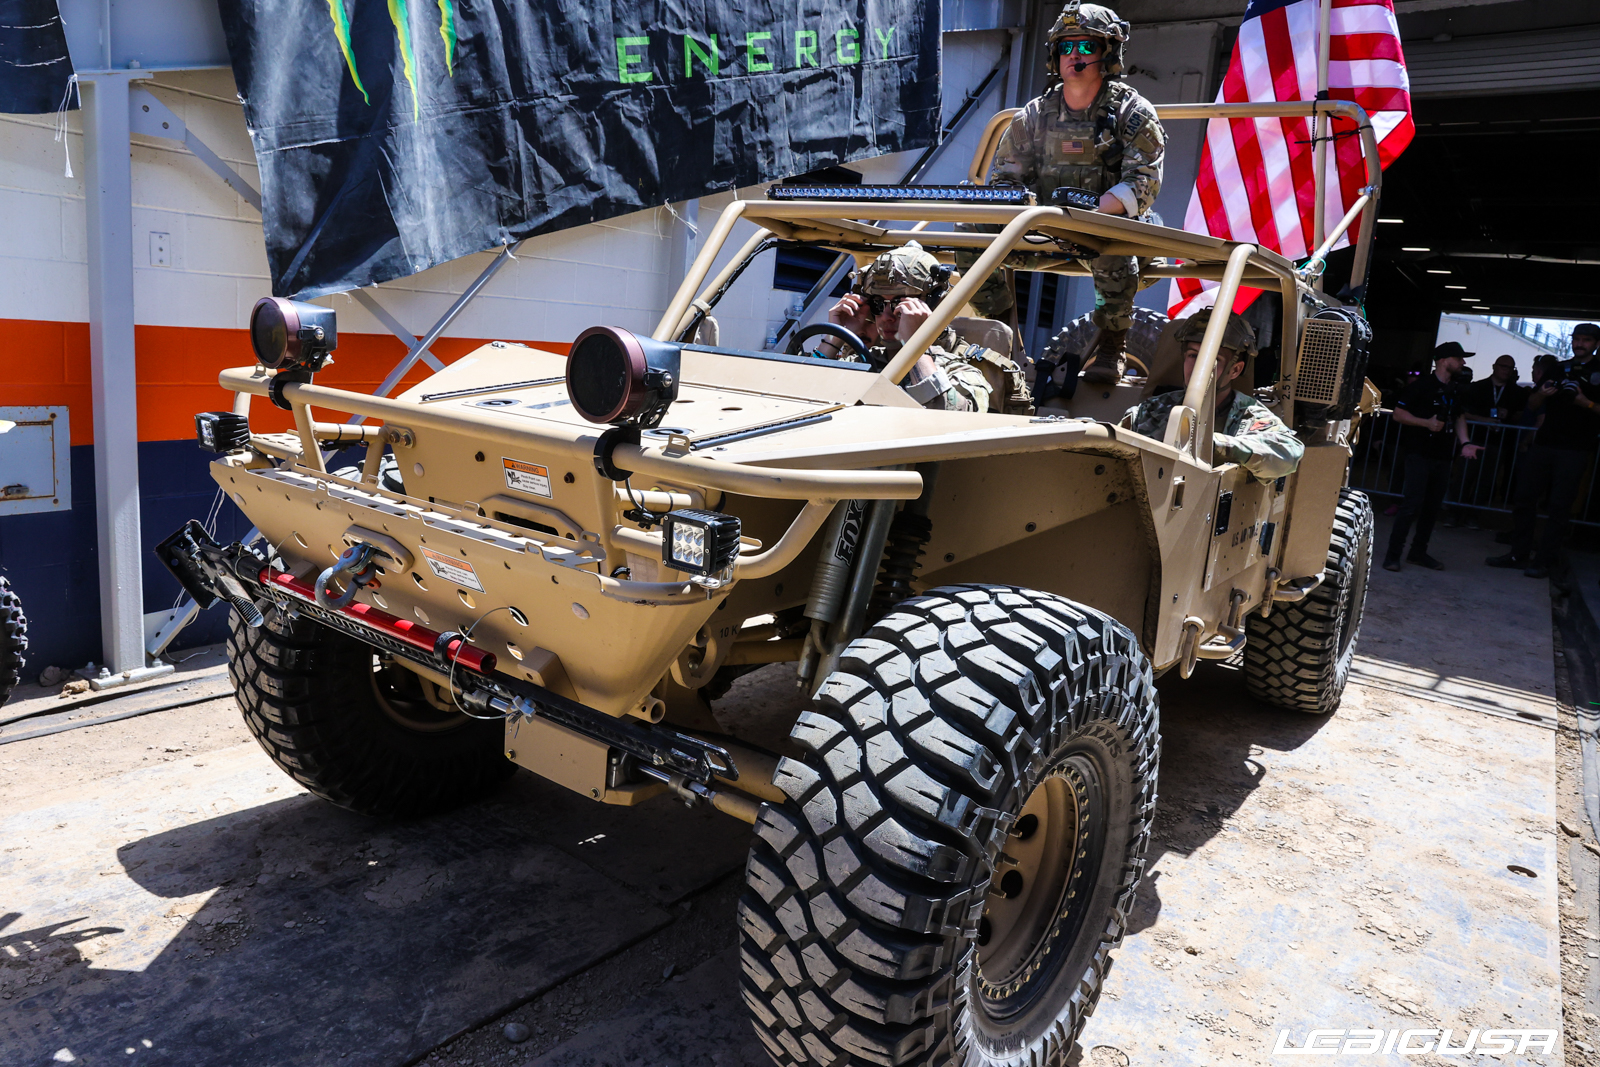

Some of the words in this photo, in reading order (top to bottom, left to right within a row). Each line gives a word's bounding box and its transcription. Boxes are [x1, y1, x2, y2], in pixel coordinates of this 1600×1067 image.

[616, 27, 895, 84] ENERGY
[1124, 112, 1143, 137] TACP
[1282, 385, 1291, 400] 2.5
[516, 463, 540, 474] WARNING
[835, 499, 867, 567] FOX
[720, 627, 730, 638] 10
[731, 624, 739, 636] K
